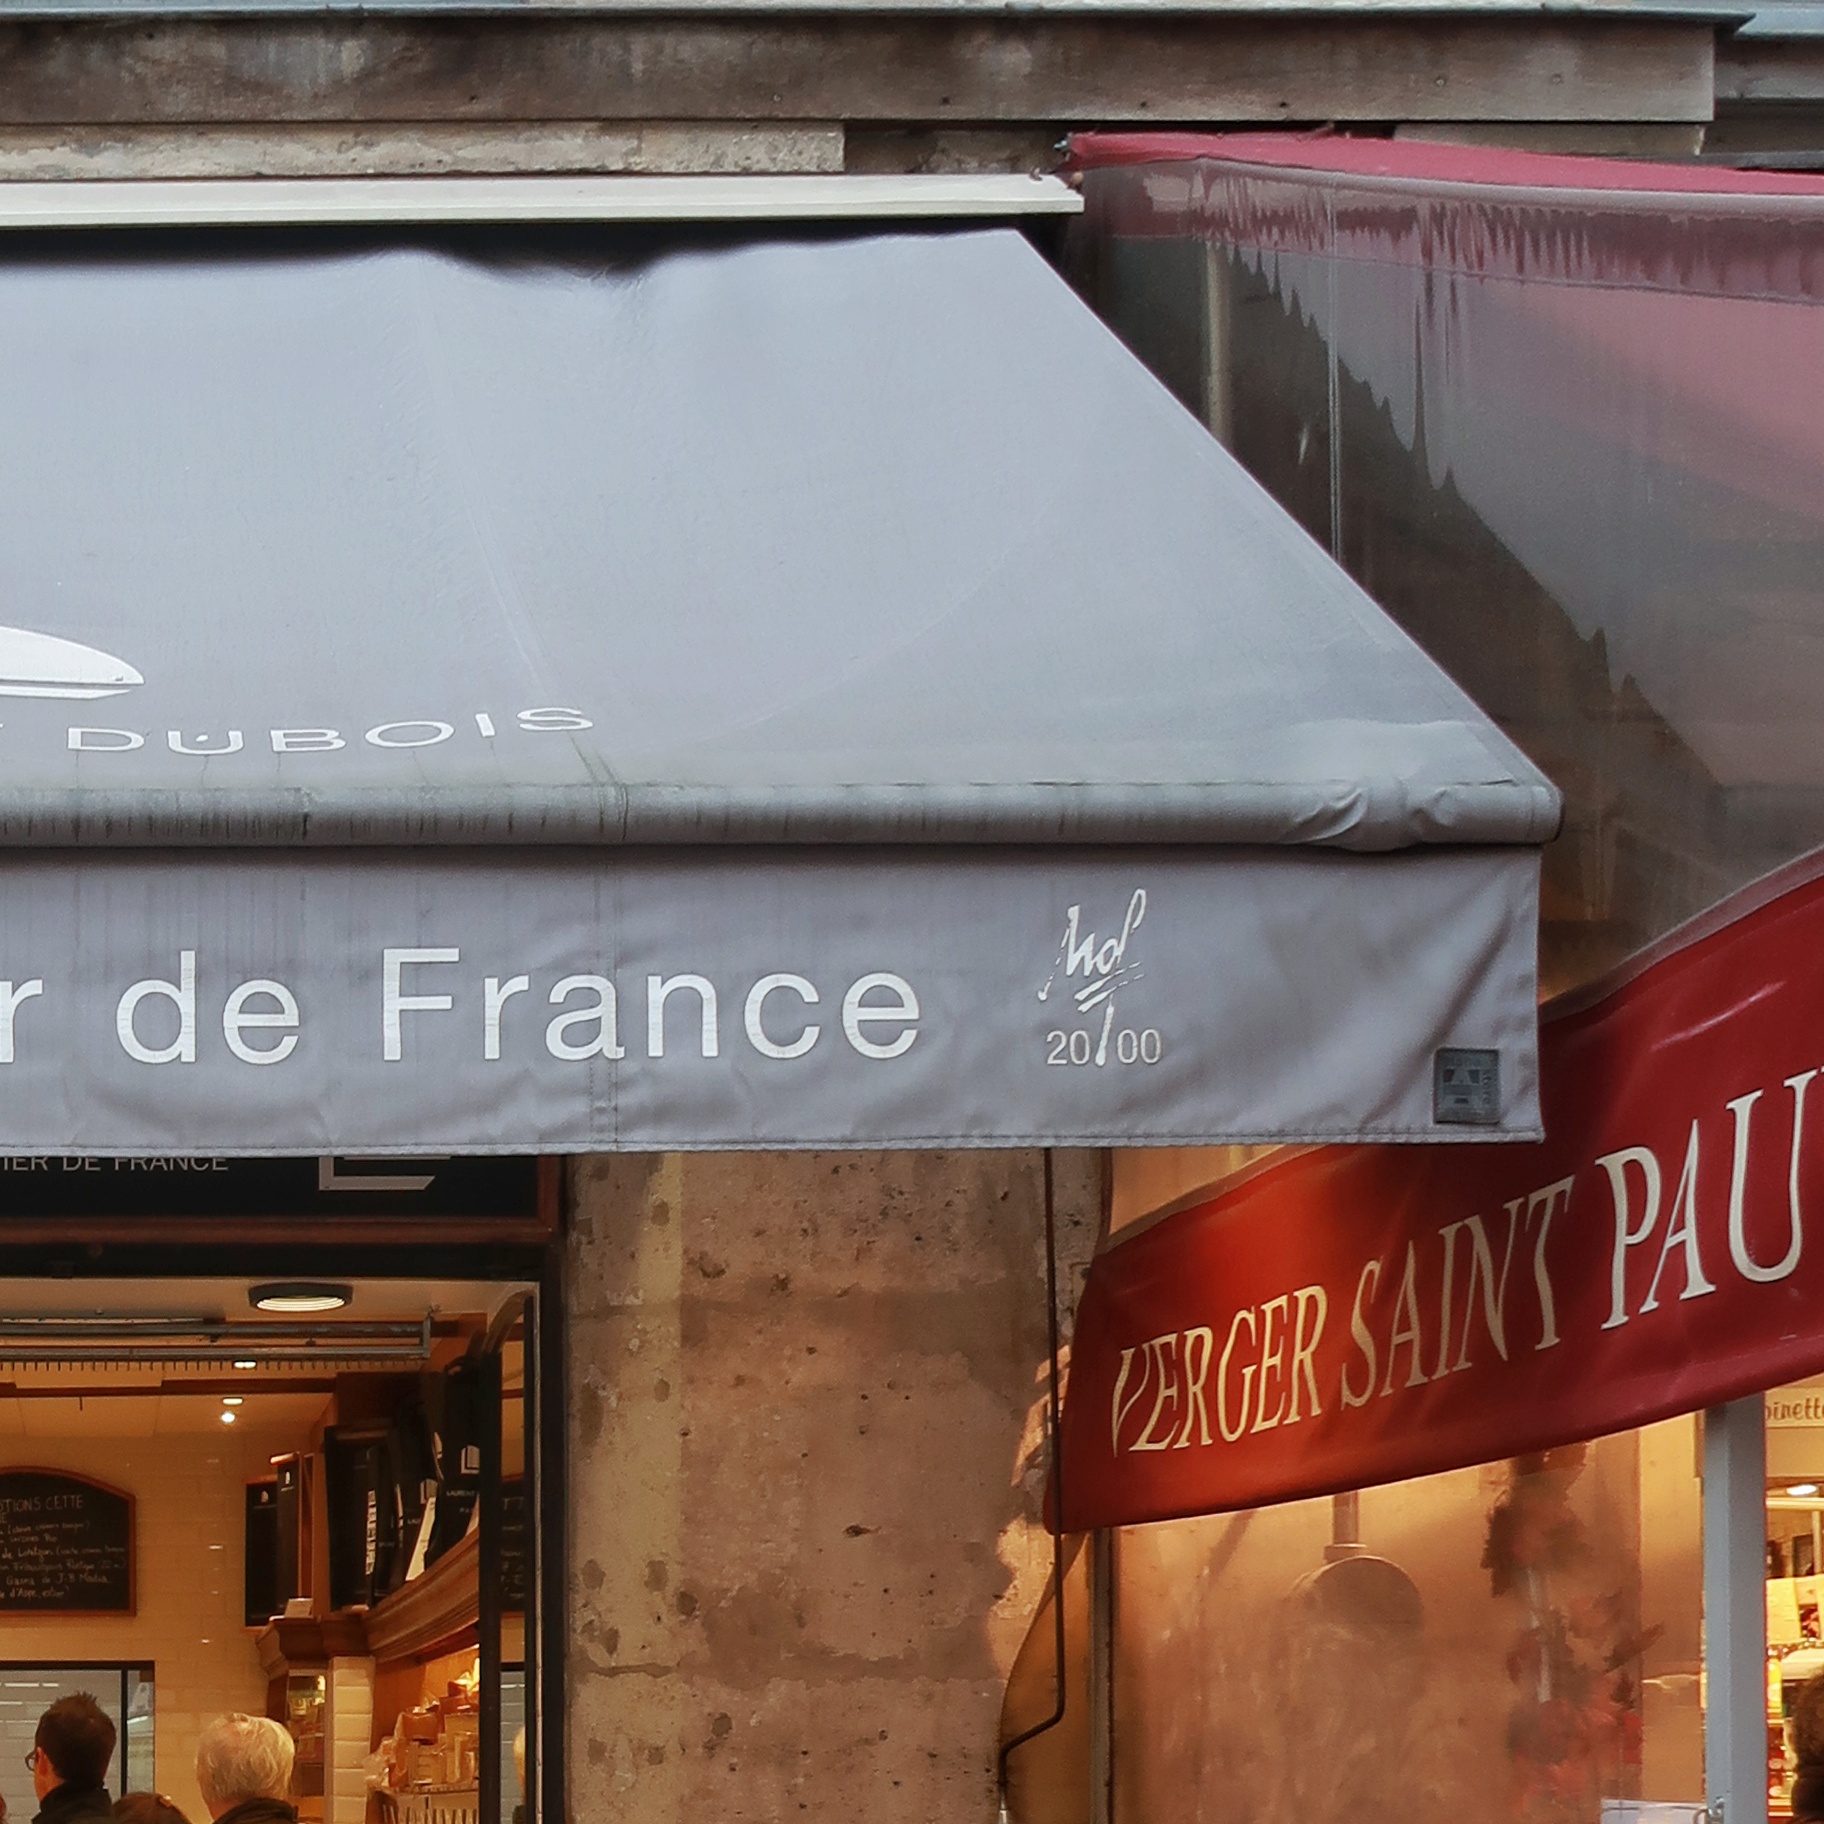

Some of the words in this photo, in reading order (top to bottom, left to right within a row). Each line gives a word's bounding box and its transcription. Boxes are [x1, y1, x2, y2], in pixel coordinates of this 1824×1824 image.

[67, 706, 594, 756] DUBOIS
[116, 951, 301, 1065] de
[380, 946, 921, 1062] France
[1111, 1284, 1329, 1459] VERGER
[1340, 1174, 1576, 1408] SAINT
[1594, 1066, 1824, 1331] PAU
[46, 1494, 84, 1511] CETTE
